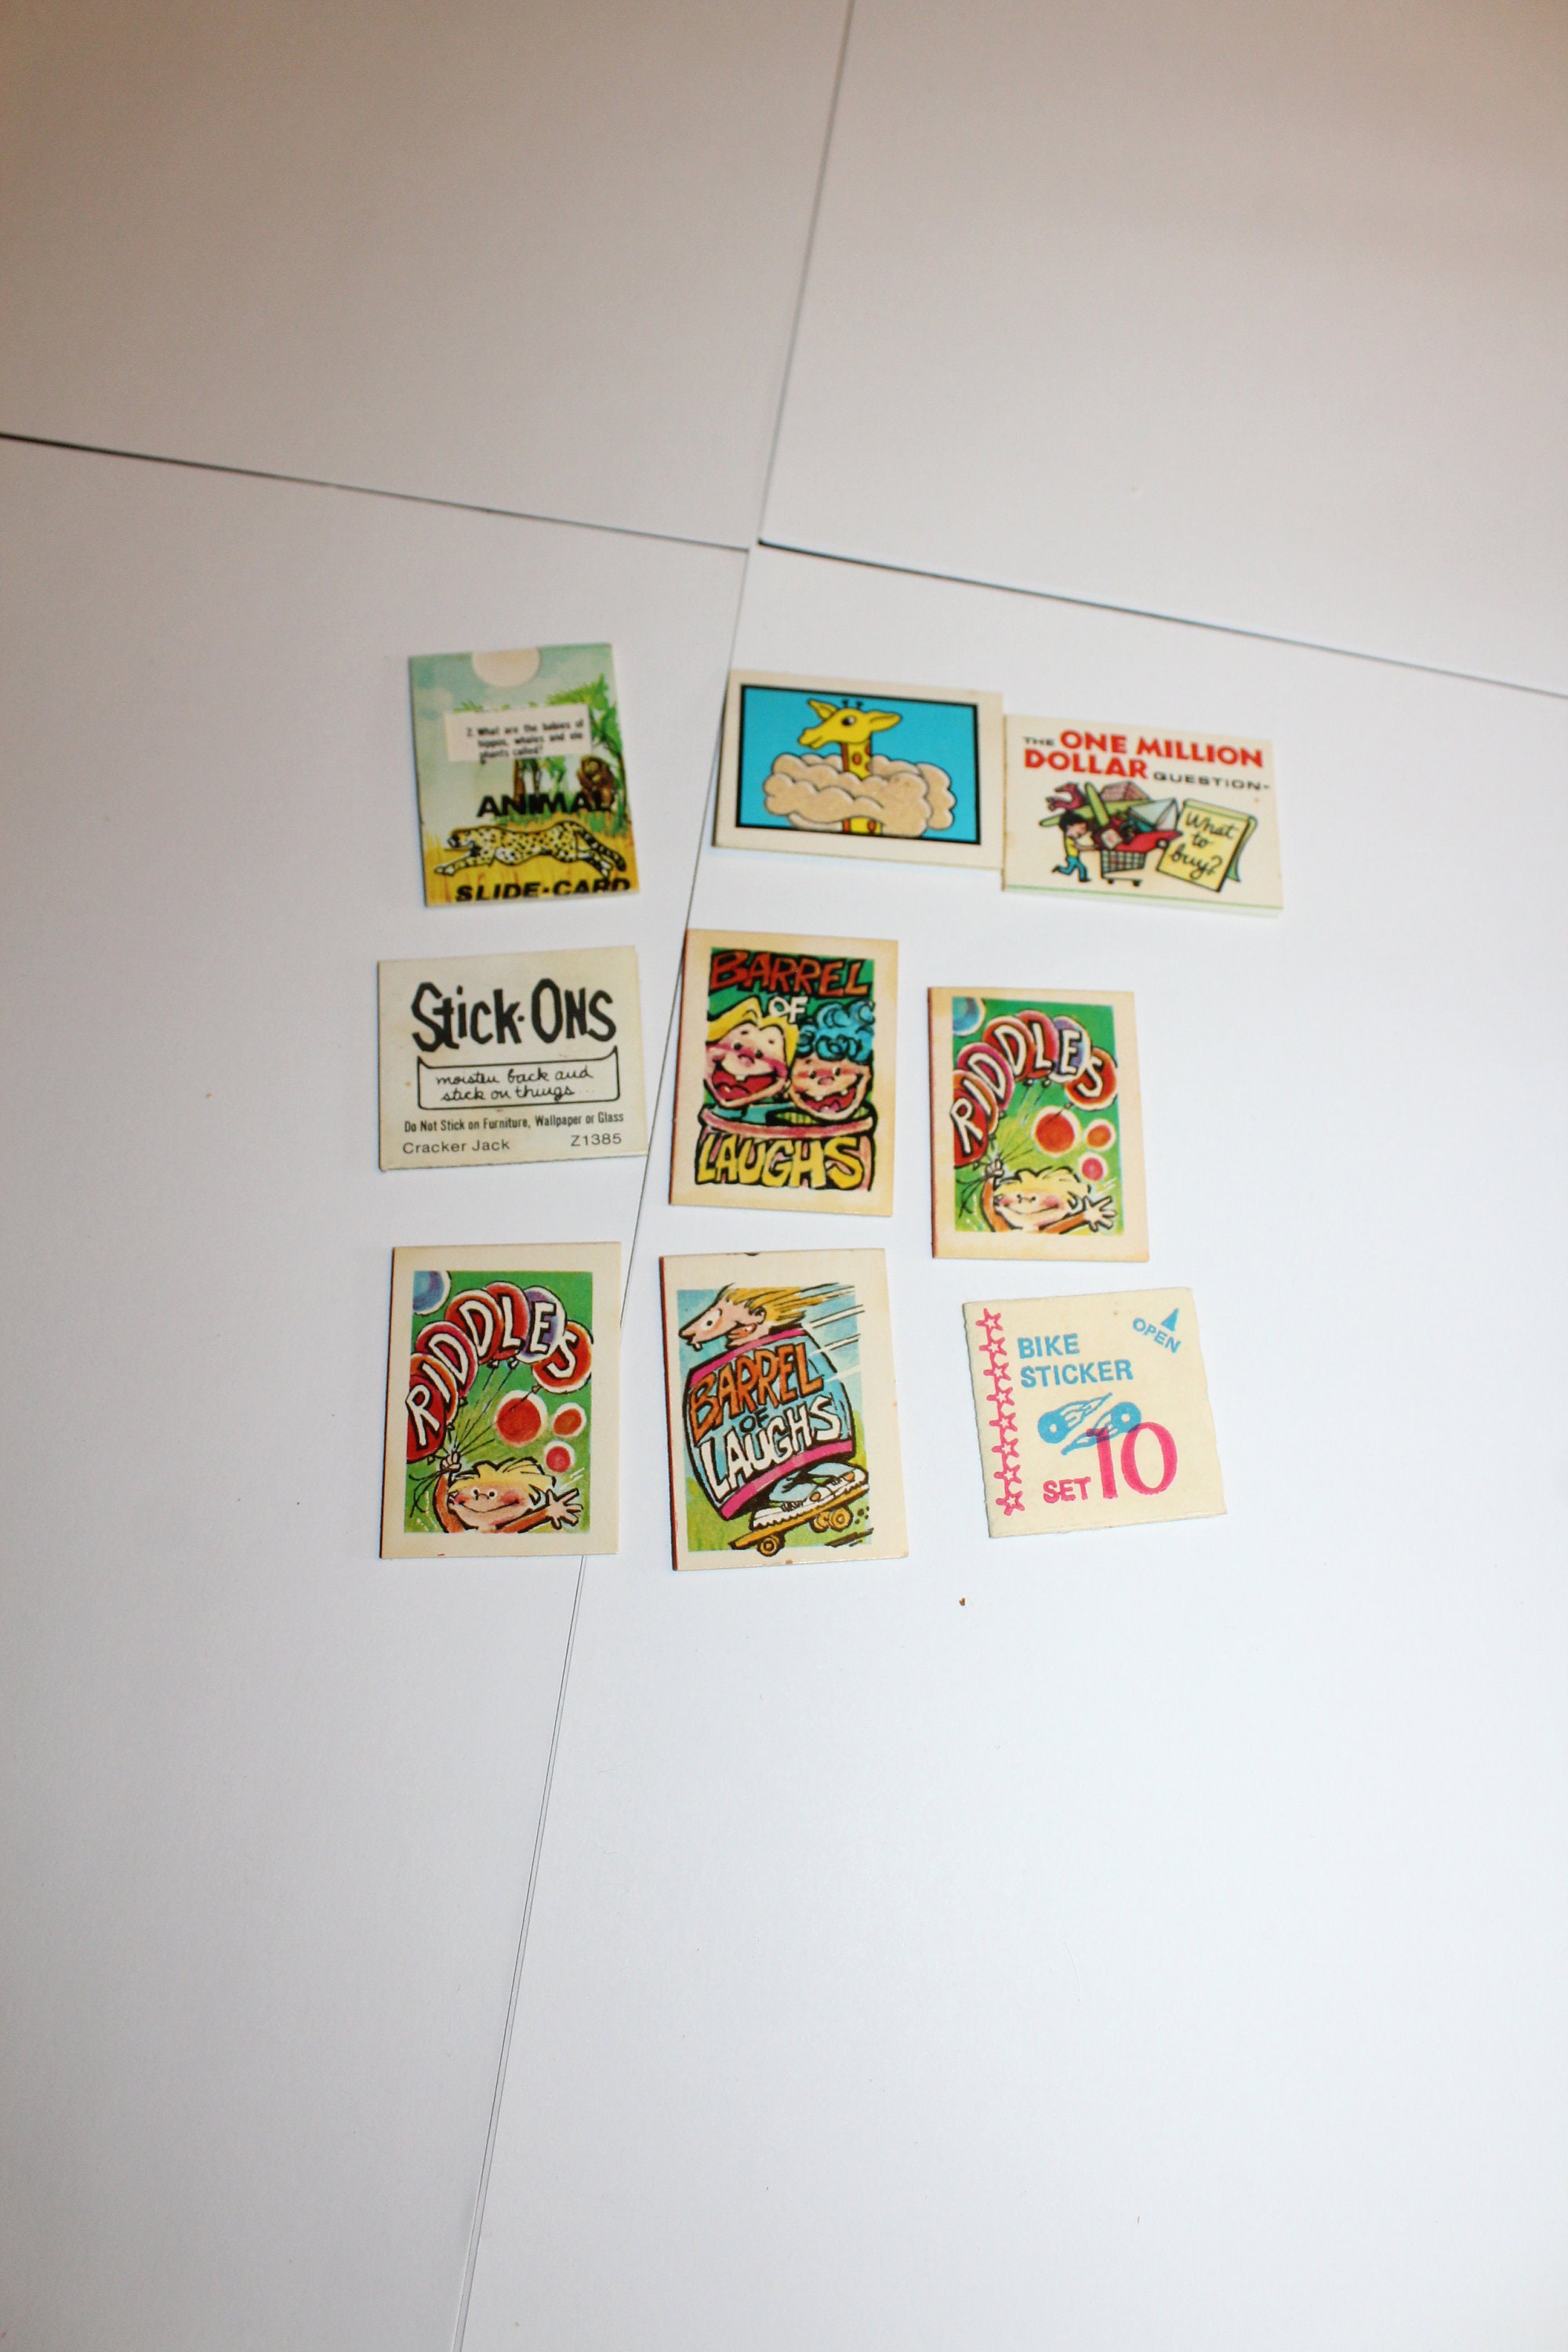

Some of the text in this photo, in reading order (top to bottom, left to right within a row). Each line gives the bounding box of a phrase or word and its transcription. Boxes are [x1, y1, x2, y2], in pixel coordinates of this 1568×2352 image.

[477, 727, 499, 735] What
[543, 722, 570, 731] babies
[575, 718, 584, 728] of
[514, 735, 544, 744] whales
[550, 732, 564, 742] and
[1022, 730, 1264, 768] THE ONE MILLION
[1024, 749, 1149, 779] DOLLAR
[477, 792, 612, 817] ANIMAL
[1185, 812, 1237, 840] What
[1191, 832, 1214, 848] to
[1170, 843, 1223, 880] buy?
[709, 950, 869, 996] BARREL
[768, 996, 808, 1023] OF
[436, 1065, 594, 1085] moisten back and
[951, 1022, 1103, 1154] RIDDLES
[441, 1085, 575, 1102] stick on things
[405, 1111, 624, 1132] Do Not Stick on Furniture, Wallpaper or Glass
[402, 1133, 622, 1154] Cracker Jack Z1385
[695, 1134, 864, 1191] LAUGHS
[1017, 1333, 1080, 1359] BIKE
[1132, 1318, 1181, 1354] OPEN
[405, 1295, 579, 1450] RIDDLES
[1021, 1359, 1134, 1388] STICKER
[689, 1341, 824, 1447] BARREL
[739, 1409, 771, 1433] OF
[698, 1396, 843, 1503] LAUGHS
[1043, 1421, 1178, 1504] SET 10
